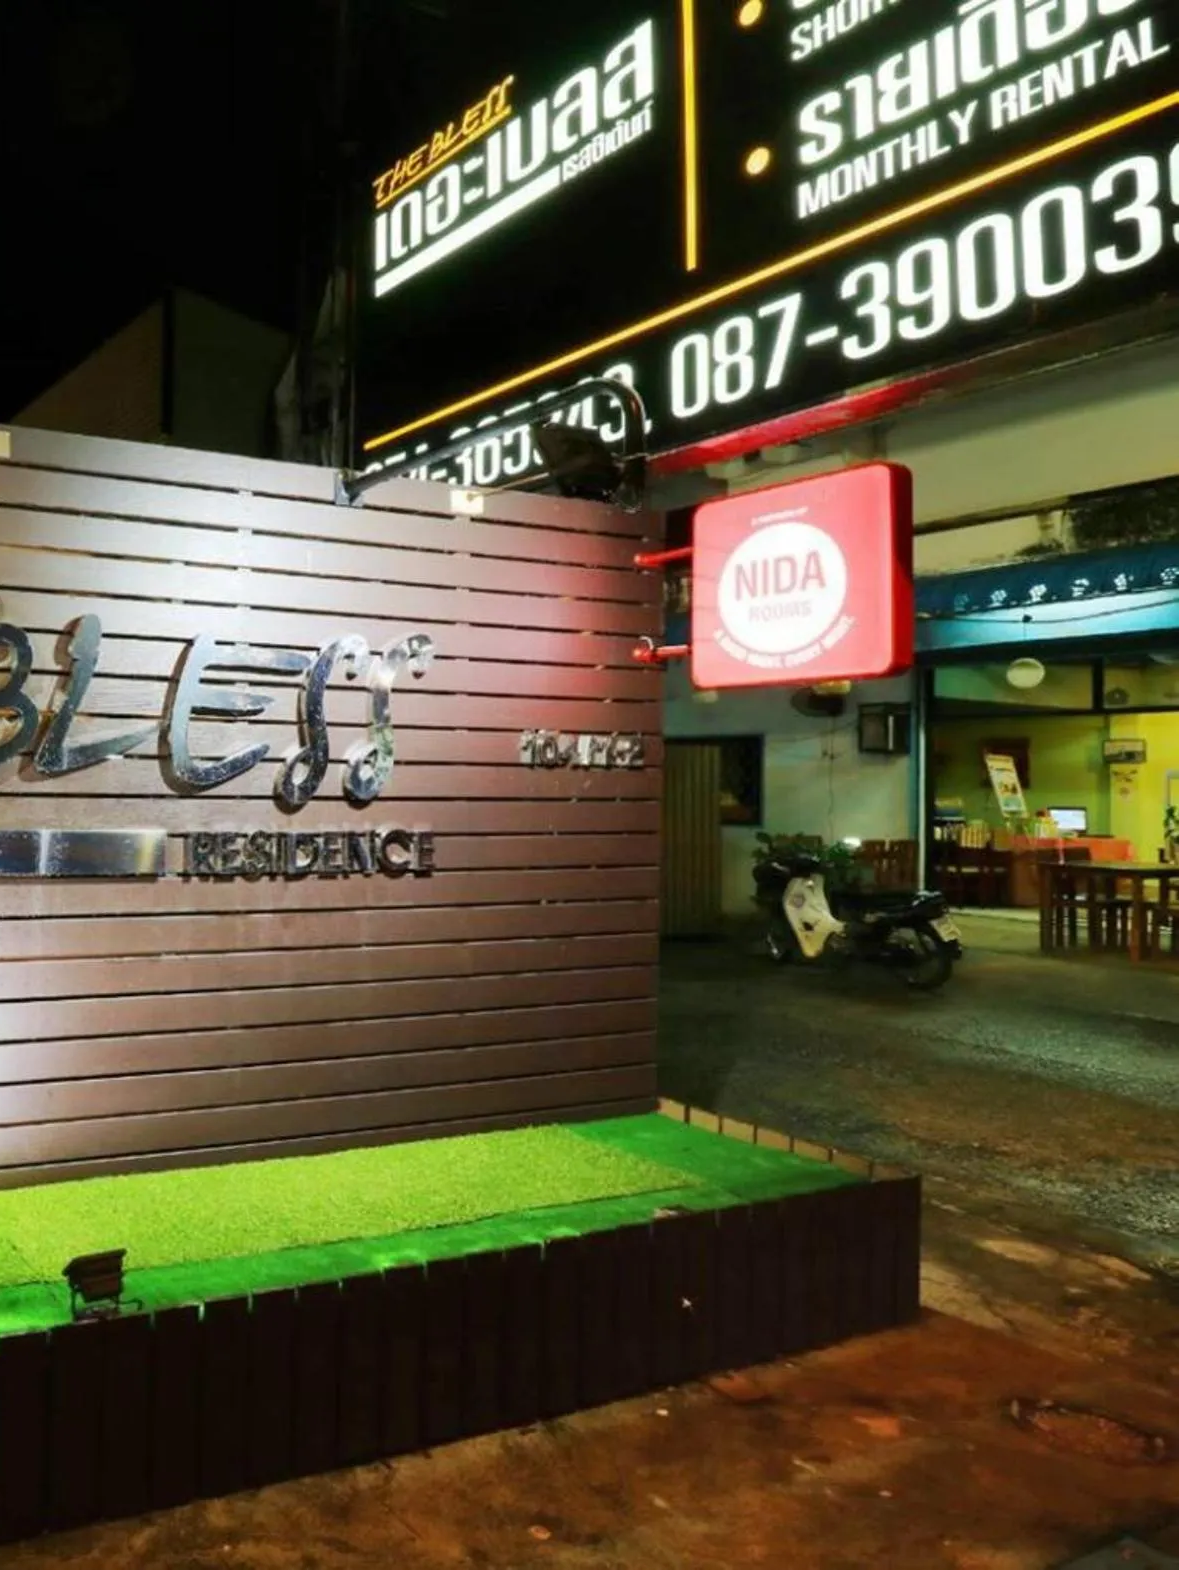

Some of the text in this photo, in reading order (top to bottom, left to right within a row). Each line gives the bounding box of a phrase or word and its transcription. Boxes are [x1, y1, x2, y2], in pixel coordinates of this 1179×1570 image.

[790, 0, 899, 61] SHO
[798, 17, 1171, 219] MONTHLY RENTAL
[373, 143, 429, 201] THE
[670, 142, 1179, 419] 087-39003
[733, 549, 827, 602] NIDA
[748, 600, 813, 623] ROOMS
[184, 829, 435, 878] RESIDENCE
